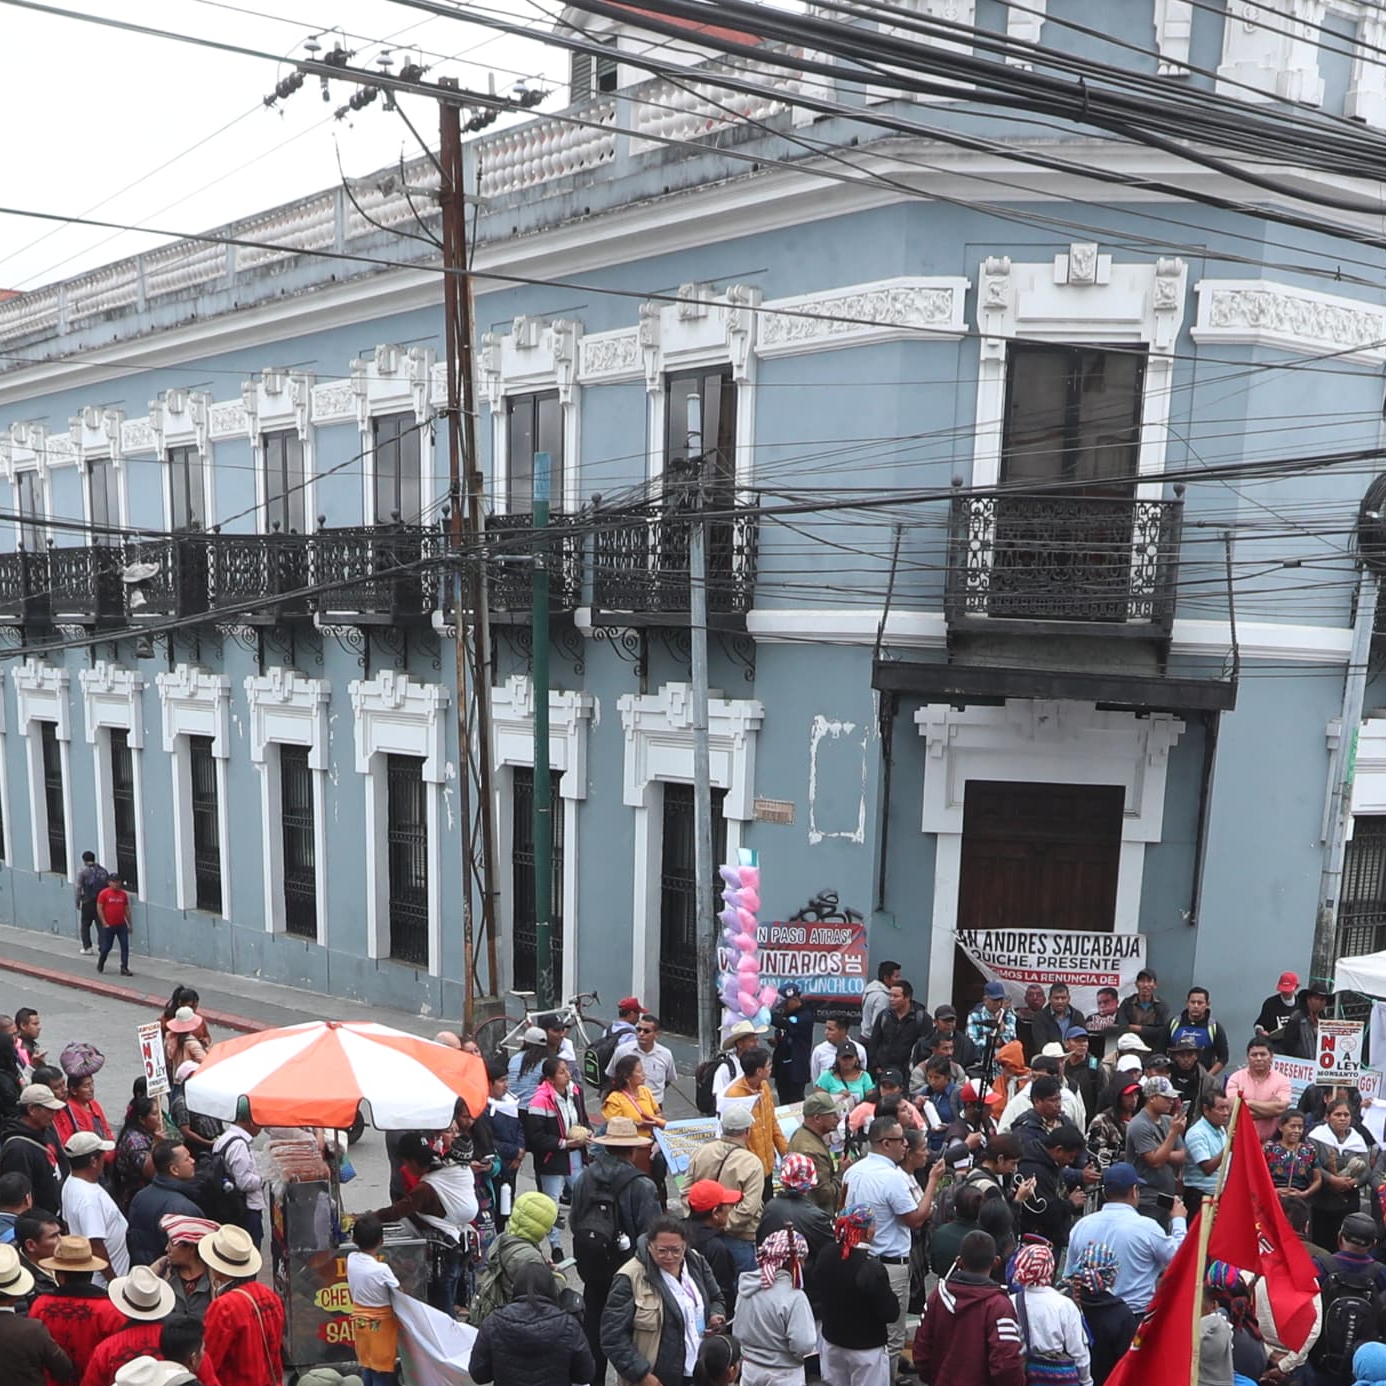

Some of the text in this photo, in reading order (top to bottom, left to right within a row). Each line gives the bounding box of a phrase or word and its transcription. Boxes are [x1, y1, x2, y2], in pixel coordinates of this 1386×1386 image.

[757, 926, 767, 943] N
[771, 927, 806, 944] PASO
[956, 930, 978, 949] AN
[983, 931, 1048, 955] ANDRES
[718, 946, 842, 976] VUNTARIOS
[844, 953, 863, 974] DE
[1036, 956, 1121, 971] PRESENTE
[1024, 971, 1041, 981] LA
[1042, 973, 1098, 984] RENUNCIA
[1099, 976, 1119, 986] DE:
[1343, 1051, 1351, 1061] A
[1273, 1060, 1314, 1082] PRESENTE
[1317, 1070, 1359, 1078] MONSANTO
[1336, 1061, 1360, 1071] LEY
